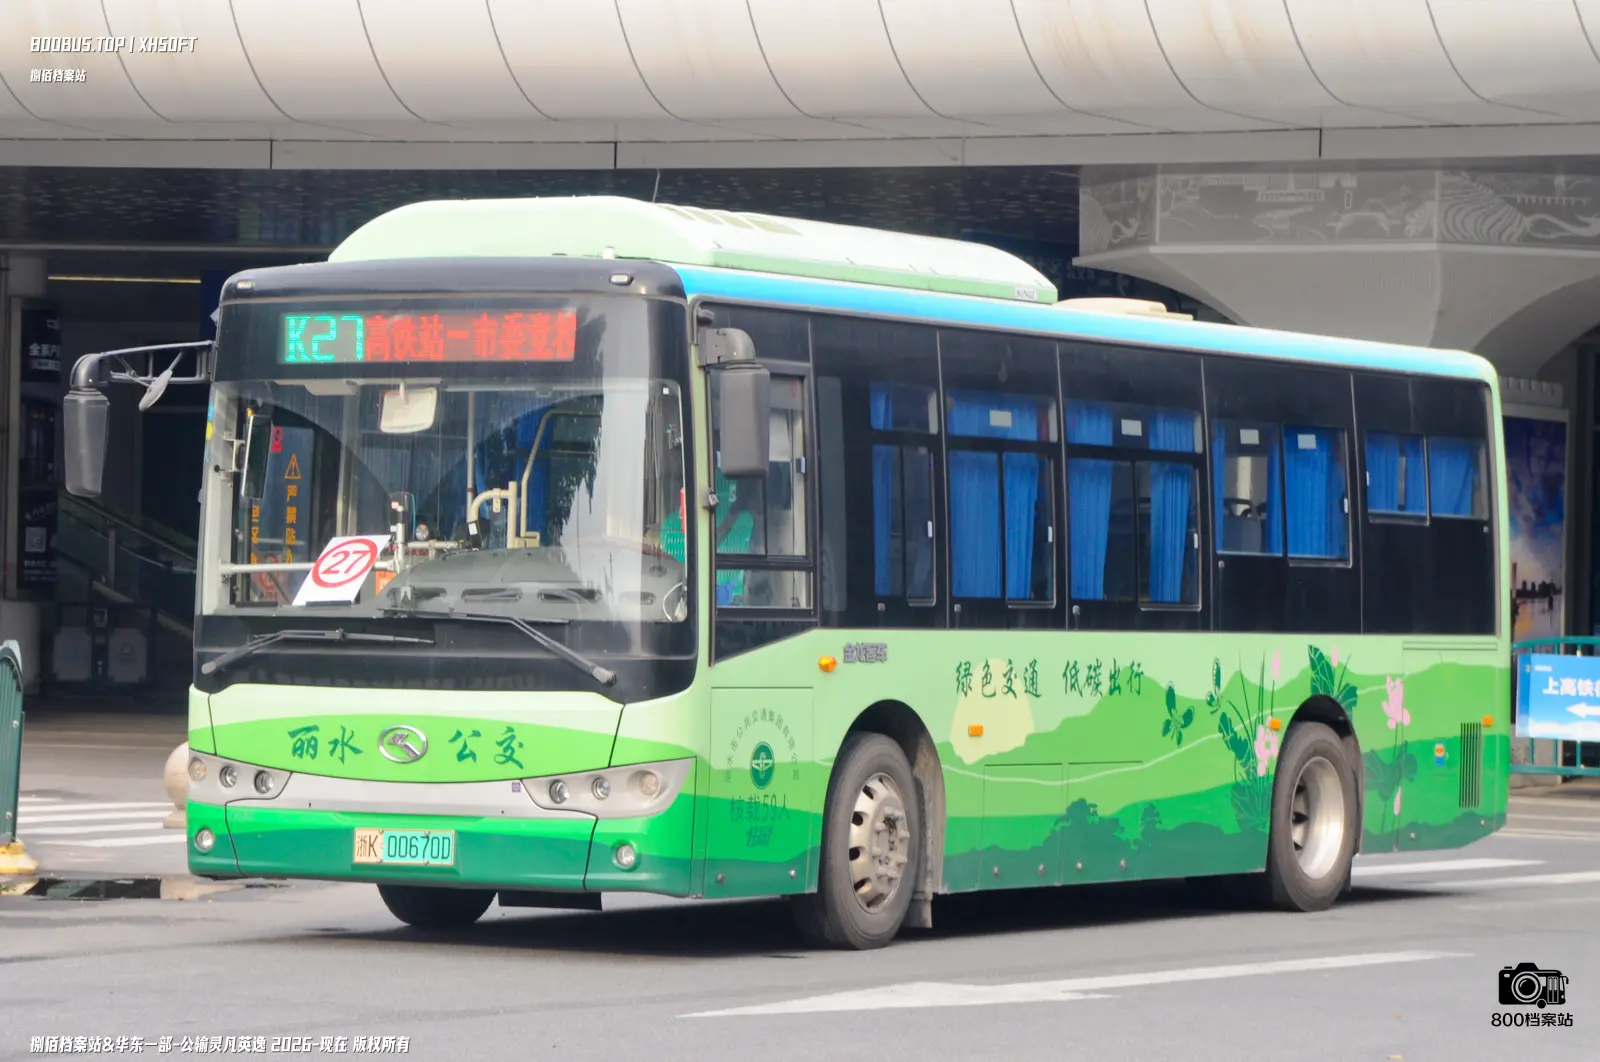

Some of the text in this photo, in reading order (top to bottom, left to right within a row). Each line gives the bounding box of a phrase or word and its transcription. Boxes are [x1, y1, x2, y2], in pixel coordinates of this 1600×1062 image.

[284, 315, 364, 361] K27
[321, 549, 370, 575] 27
[955, 657, 1144, 699] 绿色交通 低碳出行
[1542, 676, 1600, 698] 上高铁
[287, 724, 525, 770] 丽水 公交
